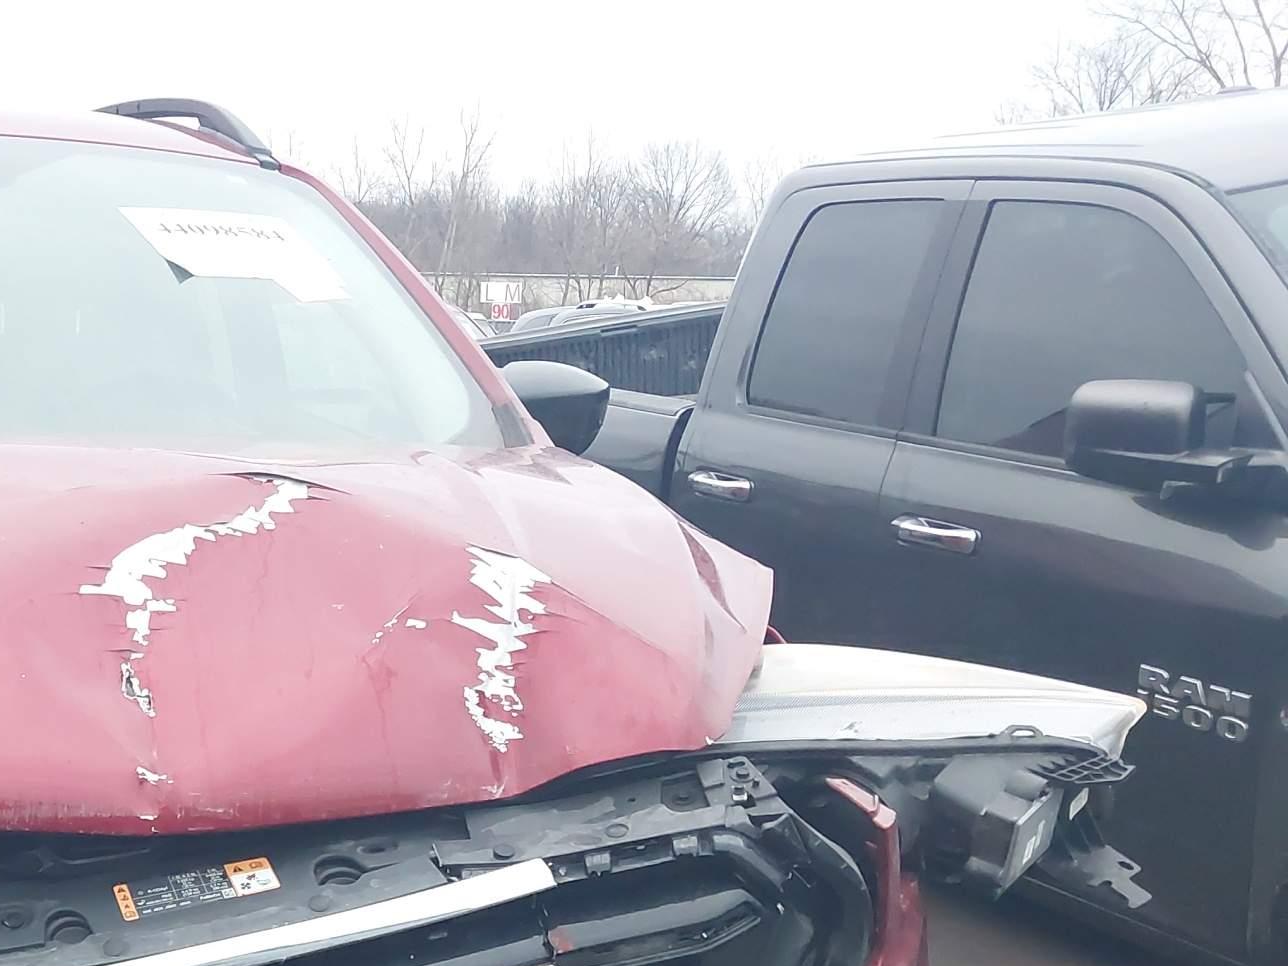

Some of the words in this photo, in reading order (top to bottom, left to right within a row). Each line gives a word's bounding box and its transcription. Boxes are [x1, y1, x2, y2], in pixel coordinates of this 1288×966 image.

[486, 283, 496, 302] L
[505, 283, 521, 302] M
[1138, 664, 1253, 716] RAM
